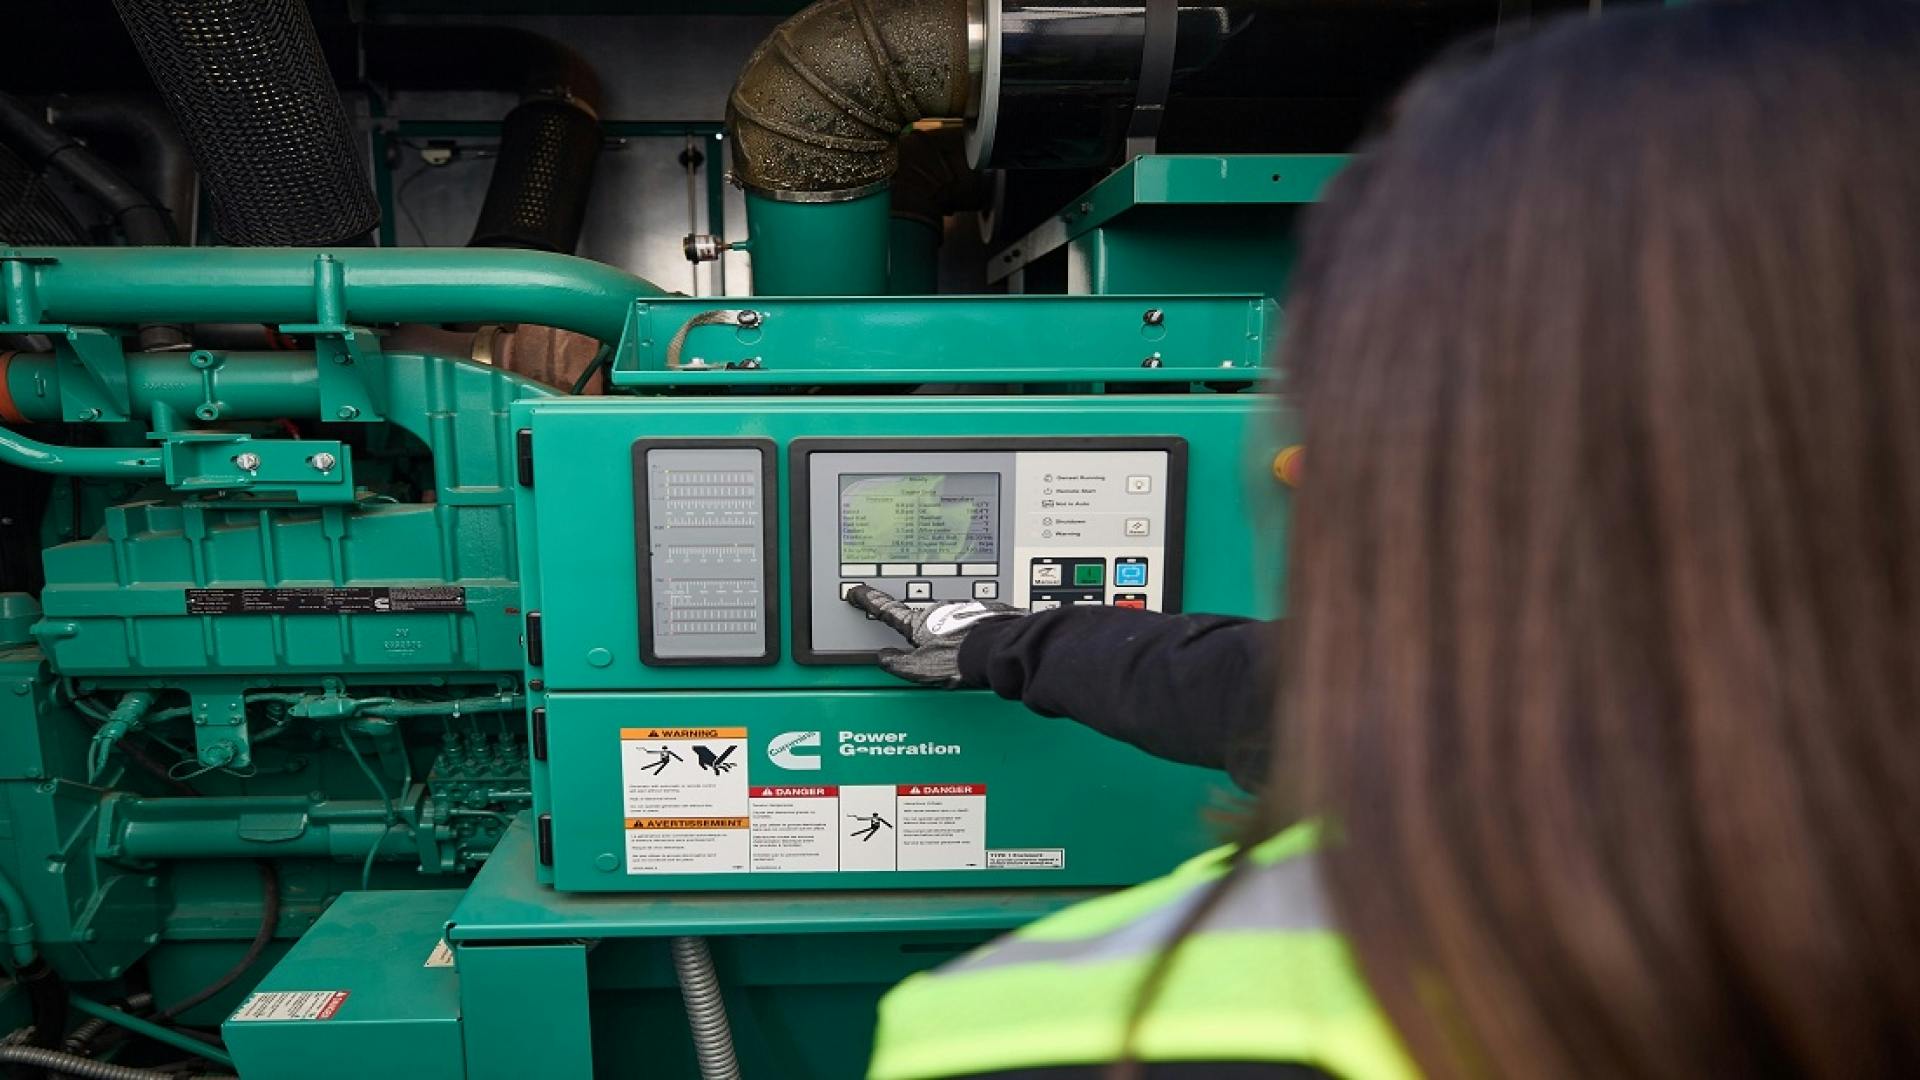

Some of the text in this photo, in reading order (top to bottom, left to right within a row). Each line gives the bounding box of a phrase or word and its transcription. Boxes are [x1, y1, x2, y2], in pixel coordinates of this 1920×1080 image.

[662, 729, 719, 738] WARNING
[838, 731, 908, 743] Power
[769, 731, 817, 757] Cummins
[839, 742, 961, 757] Generation
[647, 819, 743, 827] AVERTISSEMENT
